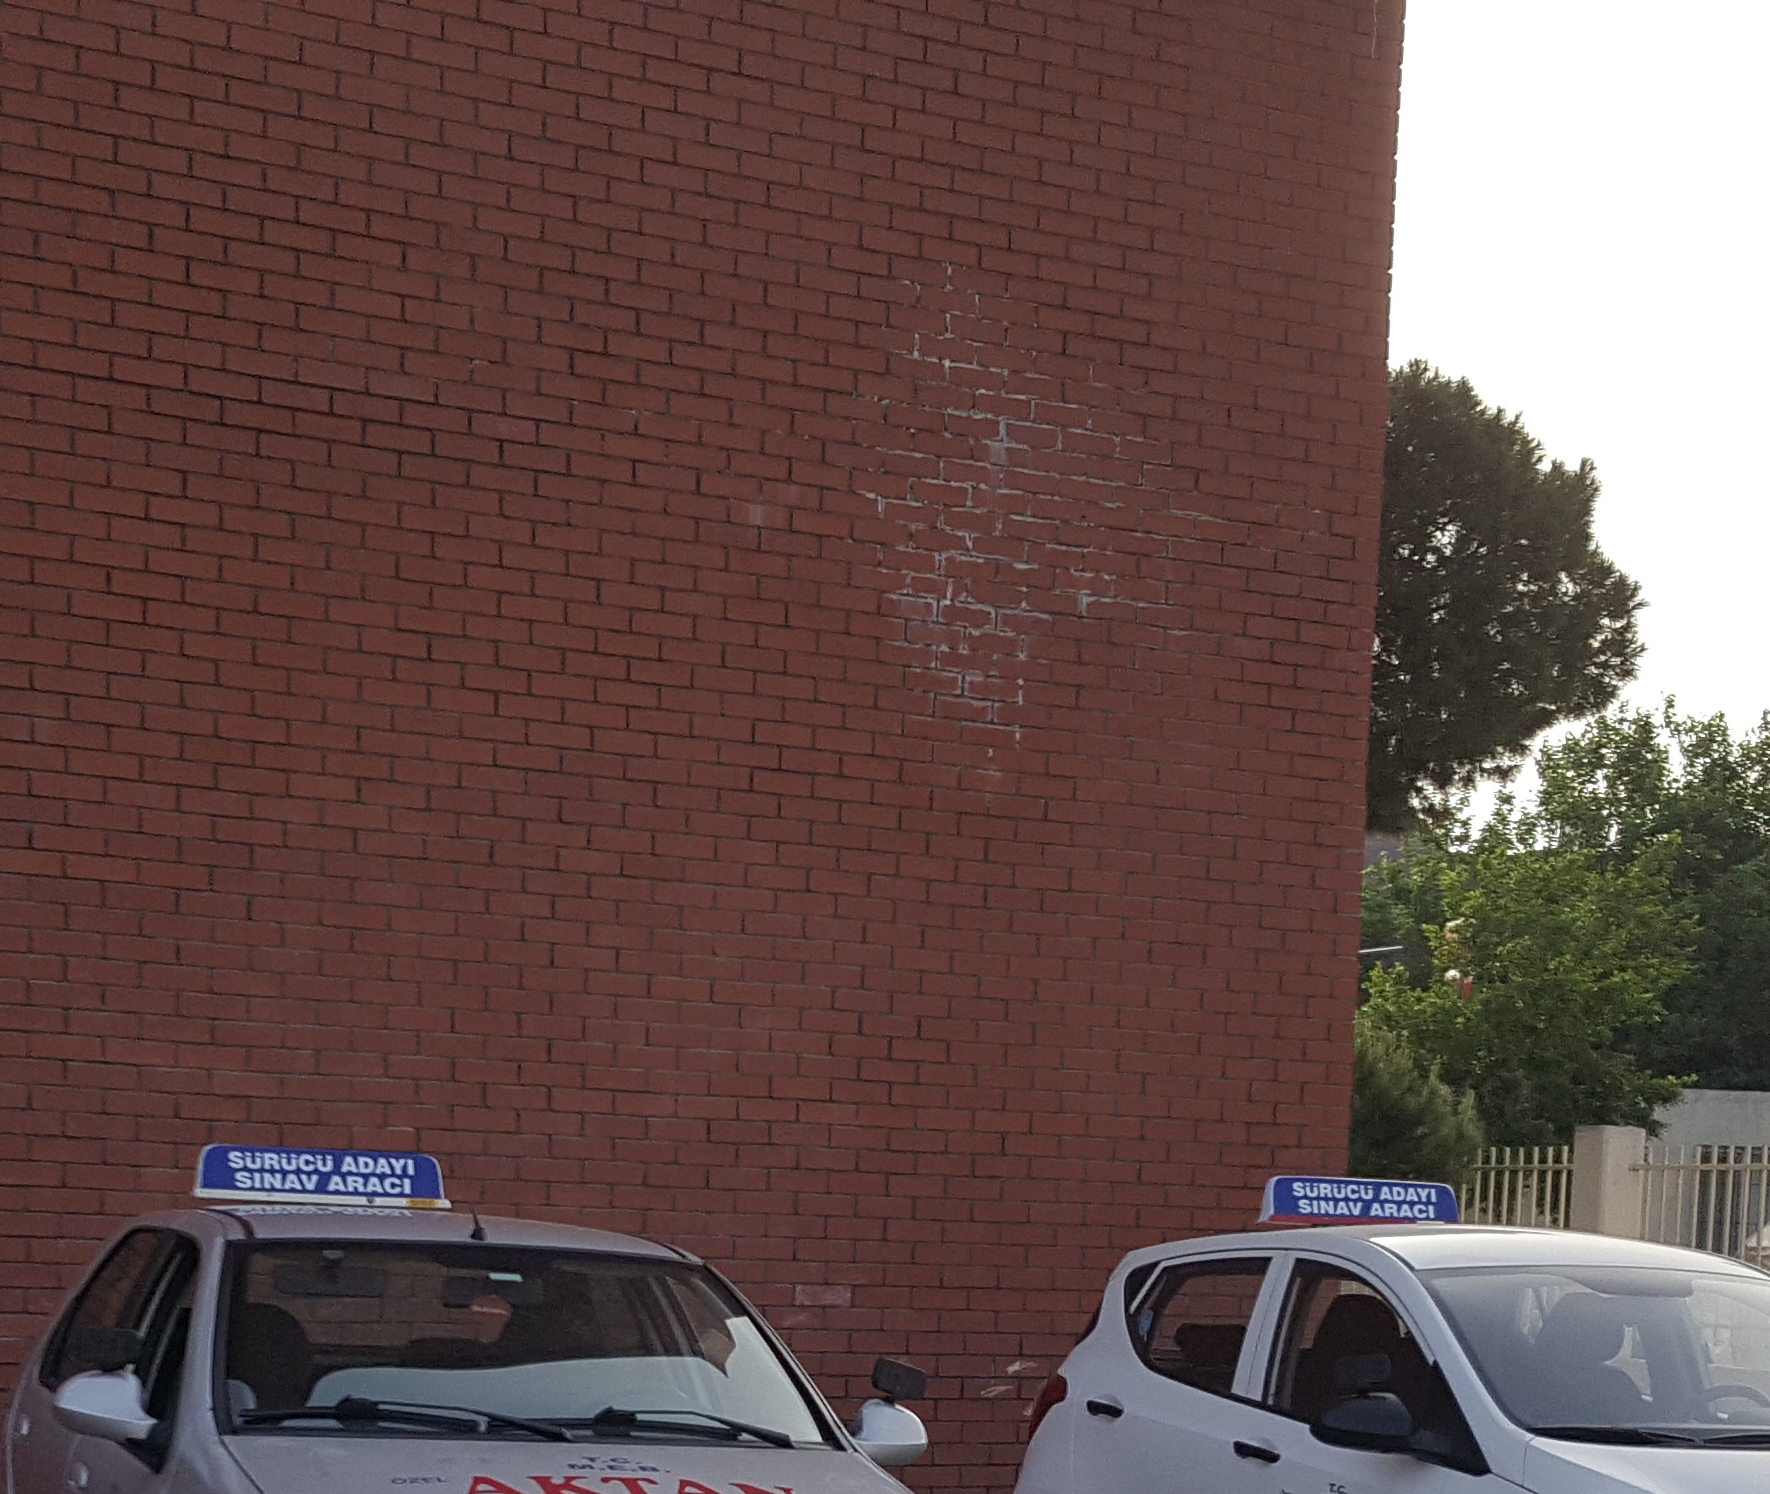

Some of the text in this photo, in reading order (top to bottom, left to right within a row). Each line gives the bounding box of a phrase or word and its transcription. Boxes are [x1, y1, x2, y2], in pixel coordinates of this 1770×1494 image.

[227, 1151, 416, 1176] SÜRÜCÜ ADAYI
[234, 1171, 412, 1195] SINAV ARACI
[1292, 1181, 1437, 1203] SÜRÜCÜ ADAYI
[1298, 1199, 1435, 1219] SINAV ARACI
